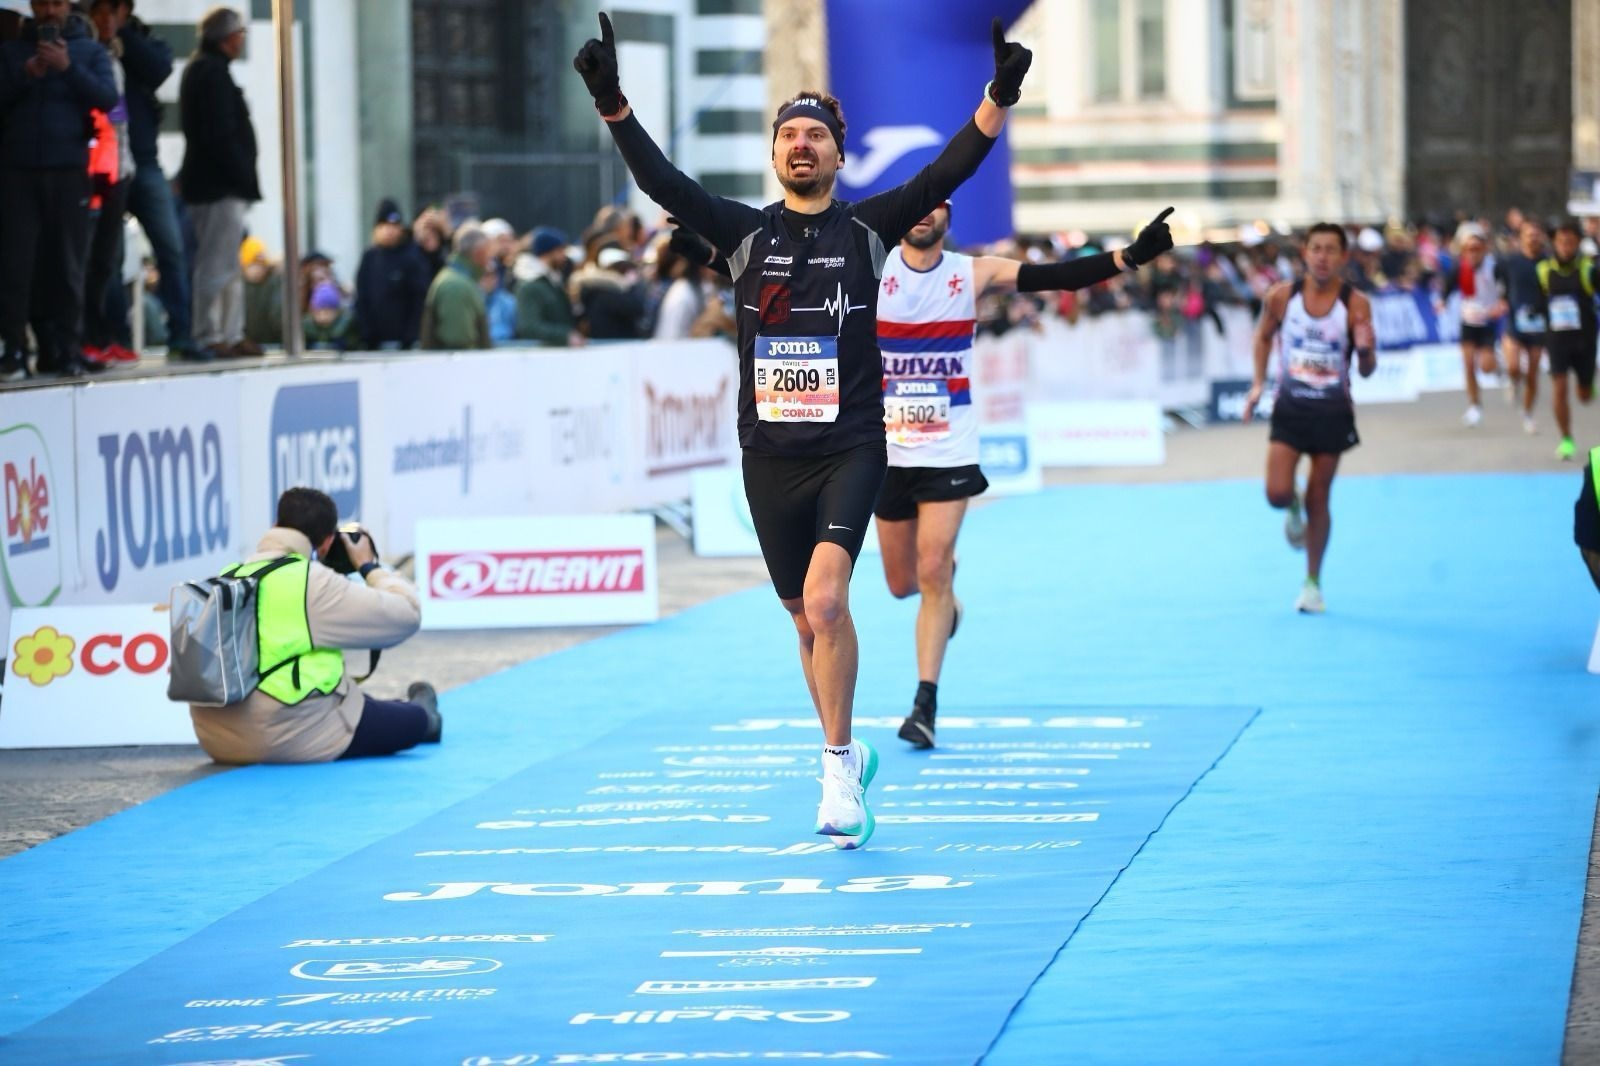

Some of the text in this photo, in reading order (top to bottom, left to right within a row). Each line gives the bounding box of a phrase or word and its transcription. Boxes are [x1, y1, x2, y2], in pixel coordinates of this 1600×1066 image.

[883, 357, 963, 376] LUIVAN
[772, 368, 820, 392] 2609
[782, 408, 823, 417] CONAD
[899, 405, 935, 424] 1502
[4, 456, 49, 537] Dole
[493, 554, 643, 593] ENERVIT
[322, 959, 477, 976] Dole
[184, 998, 274, 1009] GAME
[338, 988, 498, 1001] ATHLETICS
[549, 1050, 891, 1064] HONDA
